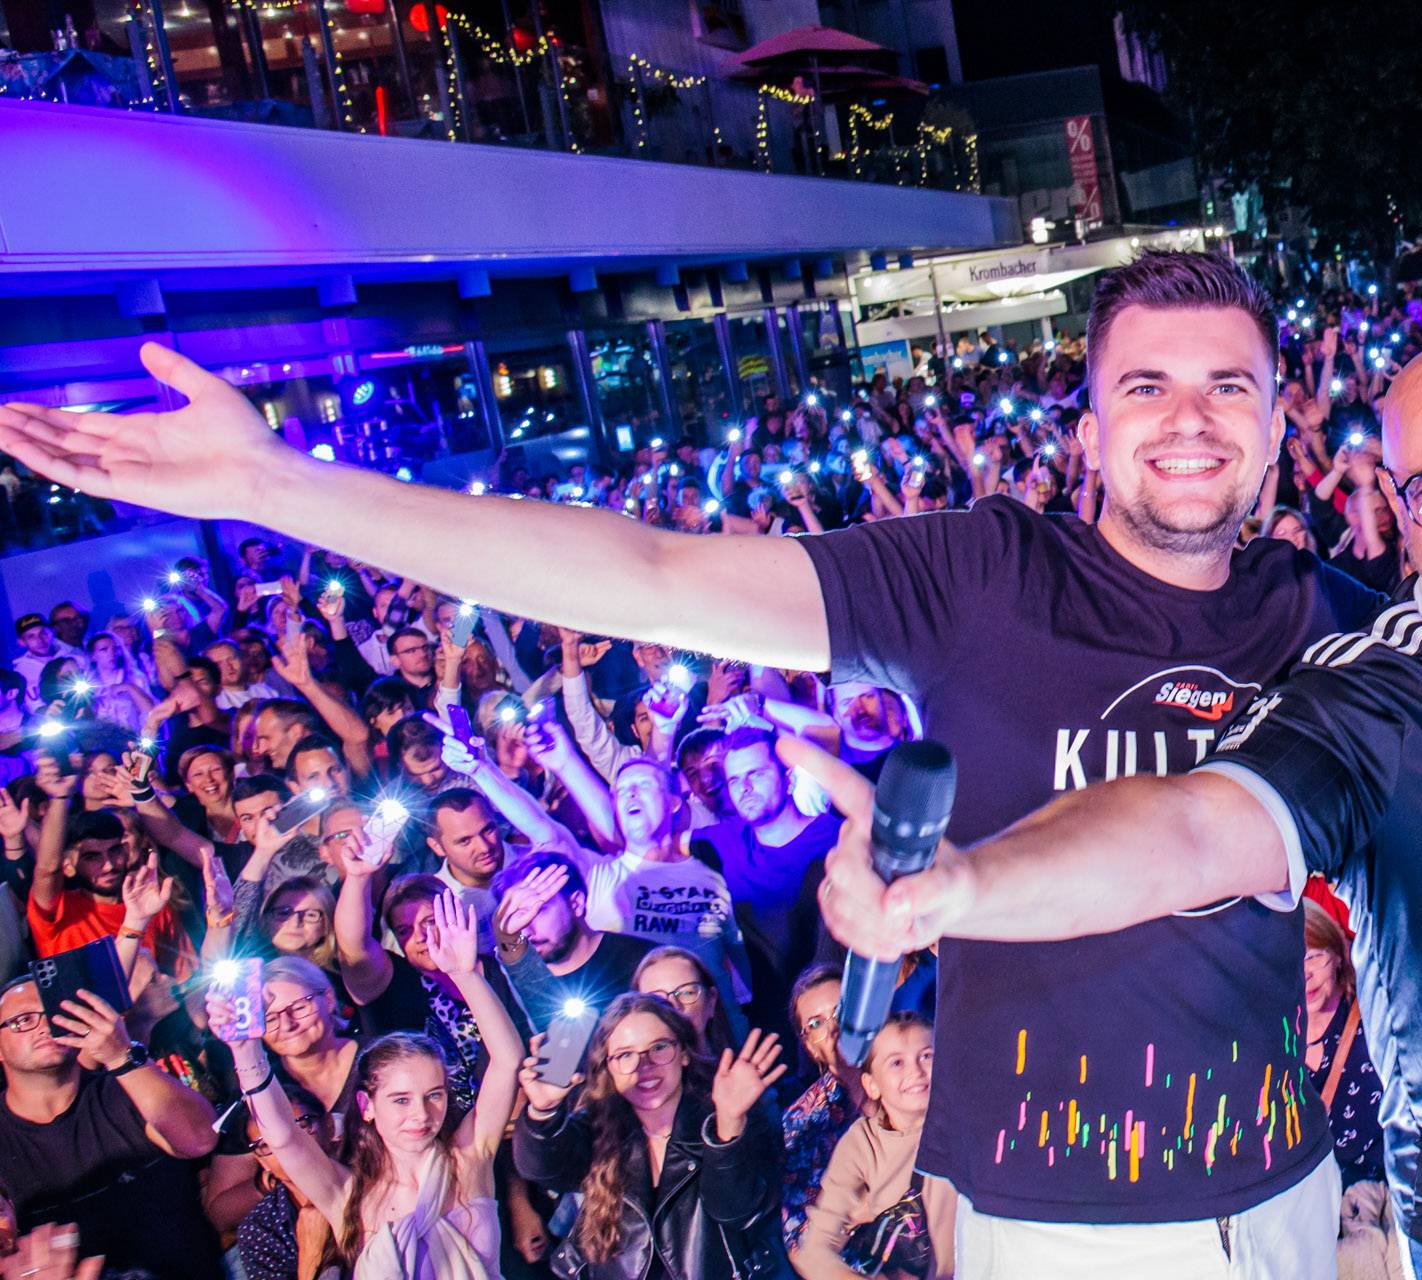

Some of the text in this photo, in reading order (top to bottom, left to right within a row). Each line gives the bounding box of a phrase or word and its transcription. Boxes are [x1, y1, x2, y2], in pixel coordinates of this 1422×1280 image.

[968, 259, 1037, 282] Krombacher
[1155, 681, 1227, 709] Siegen
[633, 914, 680, 933] RAW
